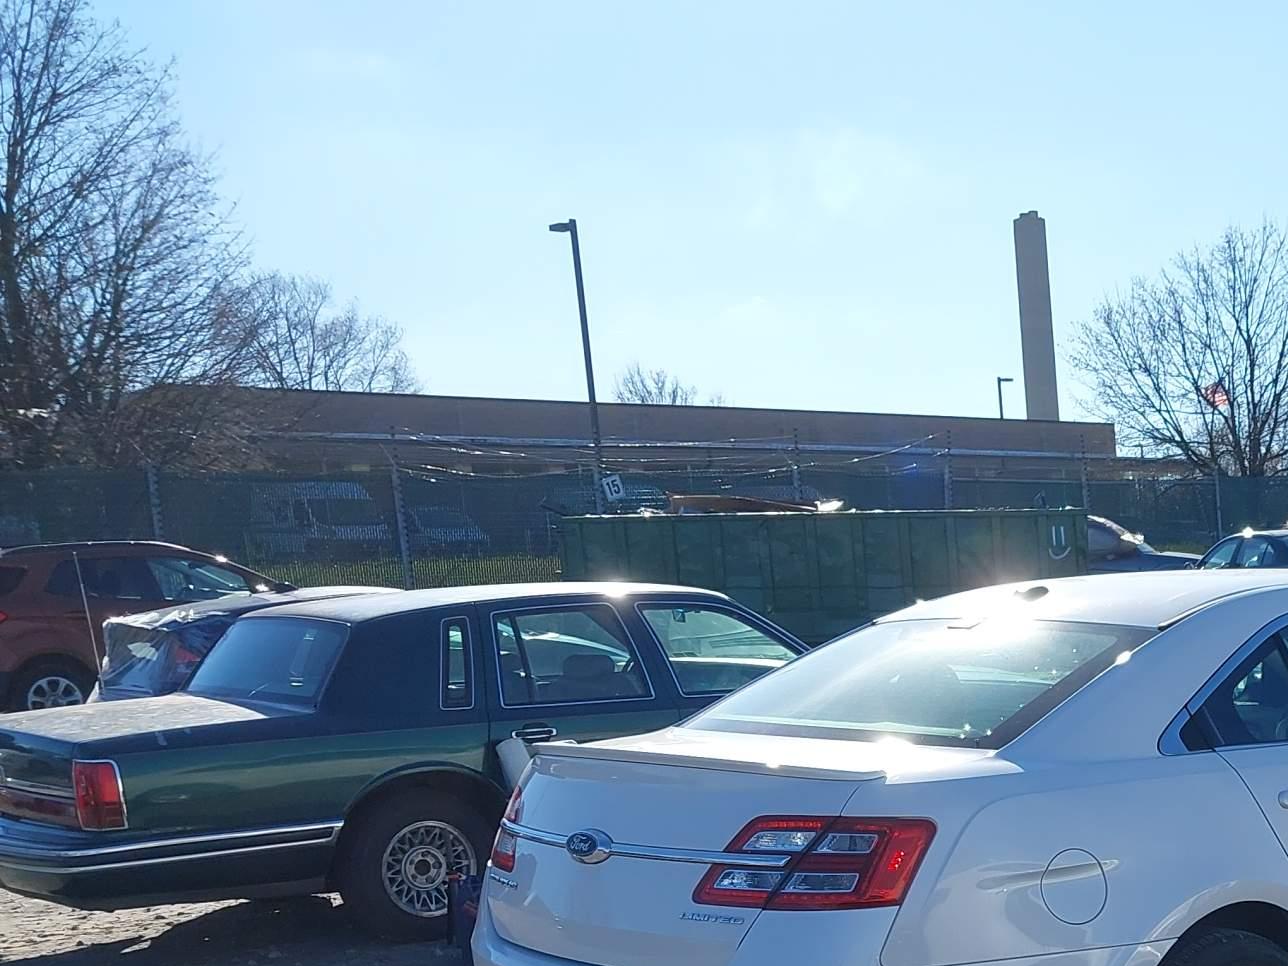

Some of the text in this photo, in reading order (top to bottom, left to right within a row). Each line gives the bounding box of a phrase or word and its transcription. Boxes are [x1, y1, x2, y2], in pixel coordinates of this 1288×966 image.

[606, 479, 621, 497] 15
[570, 834, 592, 851] Ford
[679, 912, 745, 925] LIMITED
